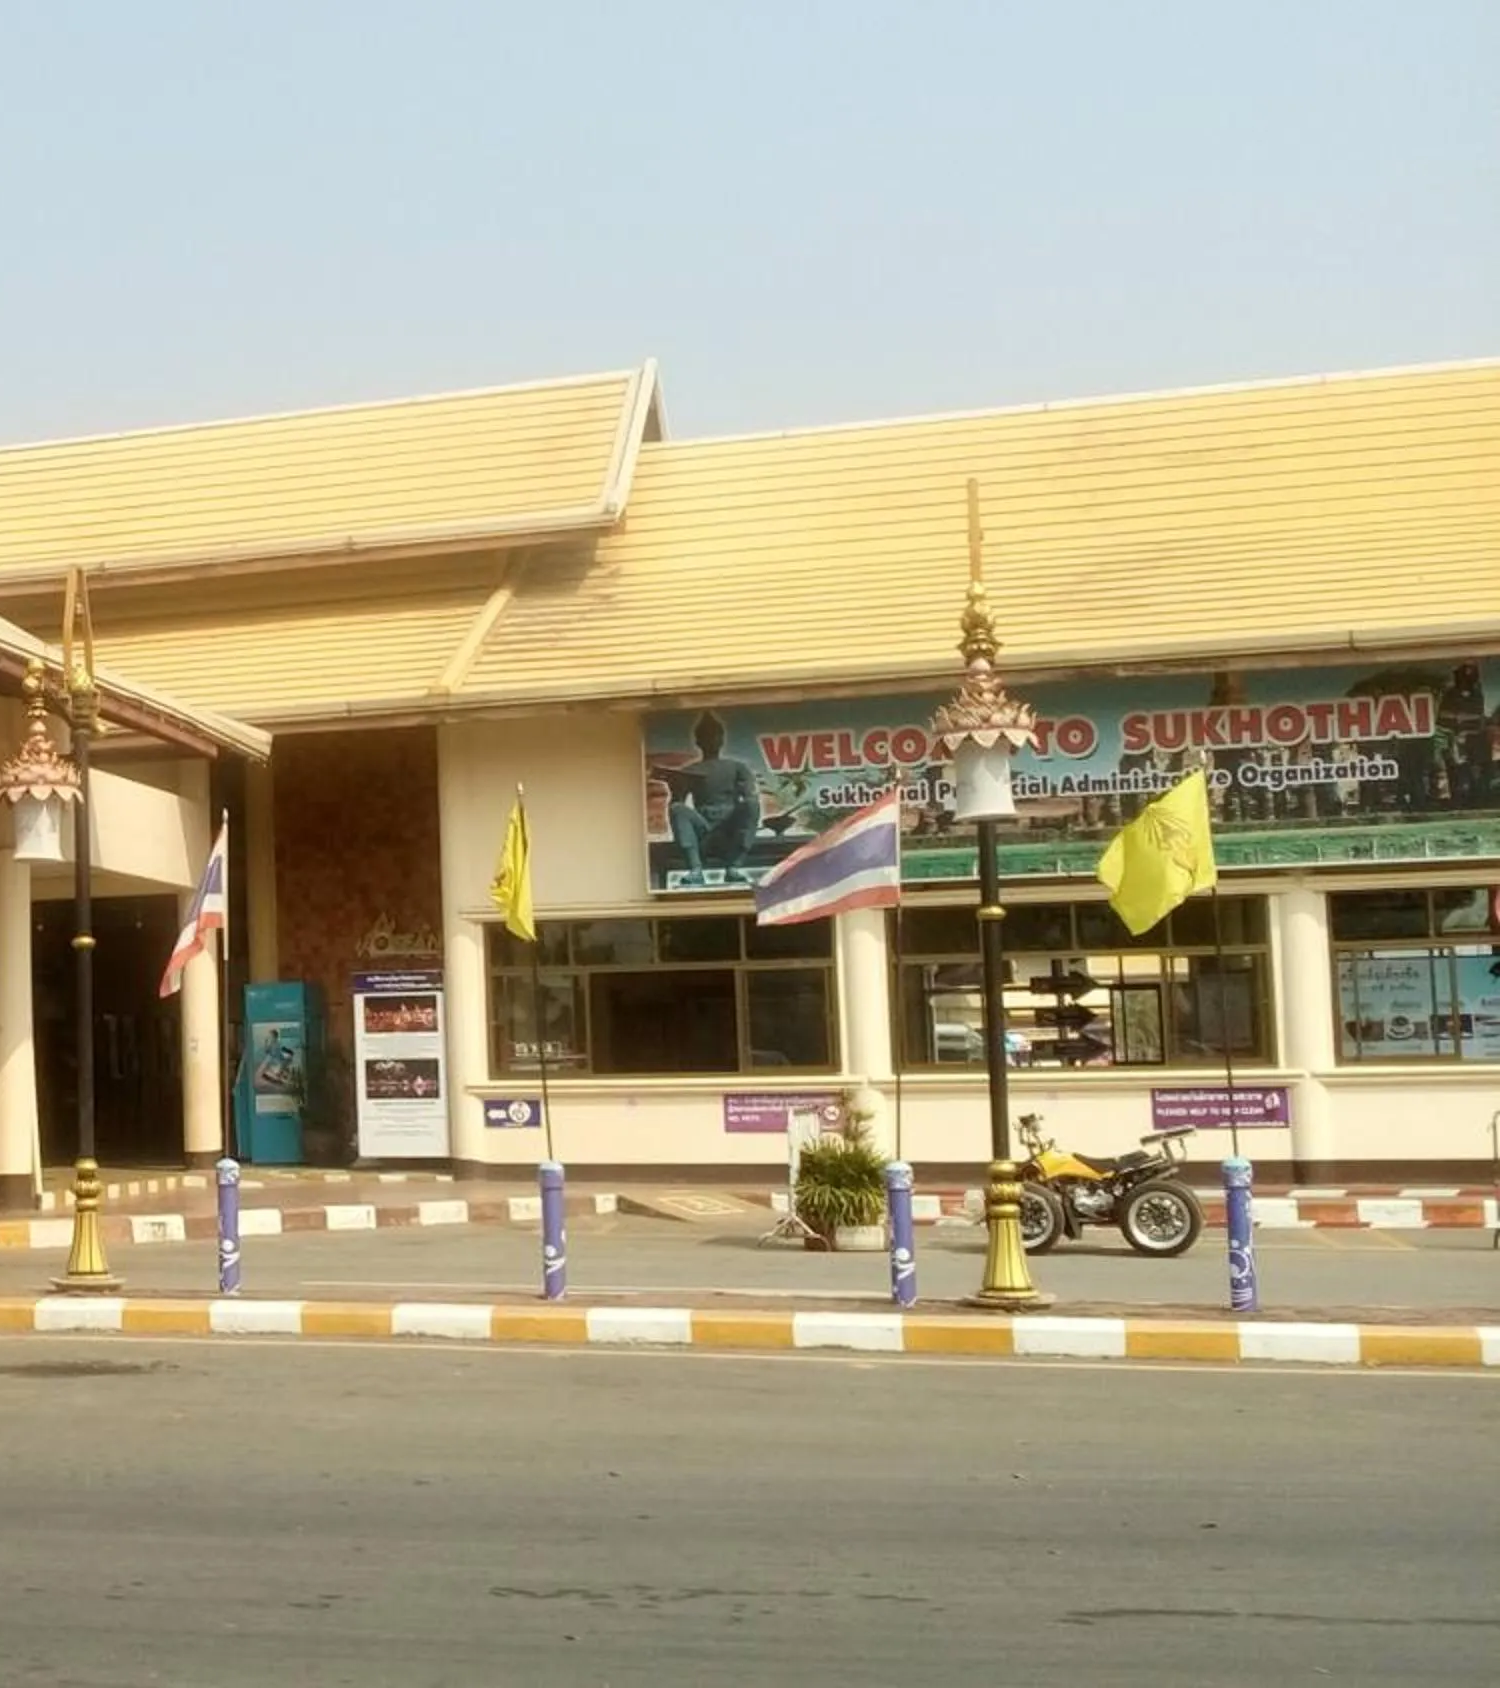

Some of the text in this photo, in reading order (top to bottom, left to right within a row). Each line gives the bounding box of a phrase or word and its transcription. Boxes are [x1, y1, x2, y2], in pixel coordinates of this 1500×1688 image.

[759, 696, 1434, 771] WELCO TO SUKHOTHAI
[818, 781, 928, 806] Sukhoai
[1061, 766, 1230, 794] Administrae
[1240, 759, 1396, 788] Organization
